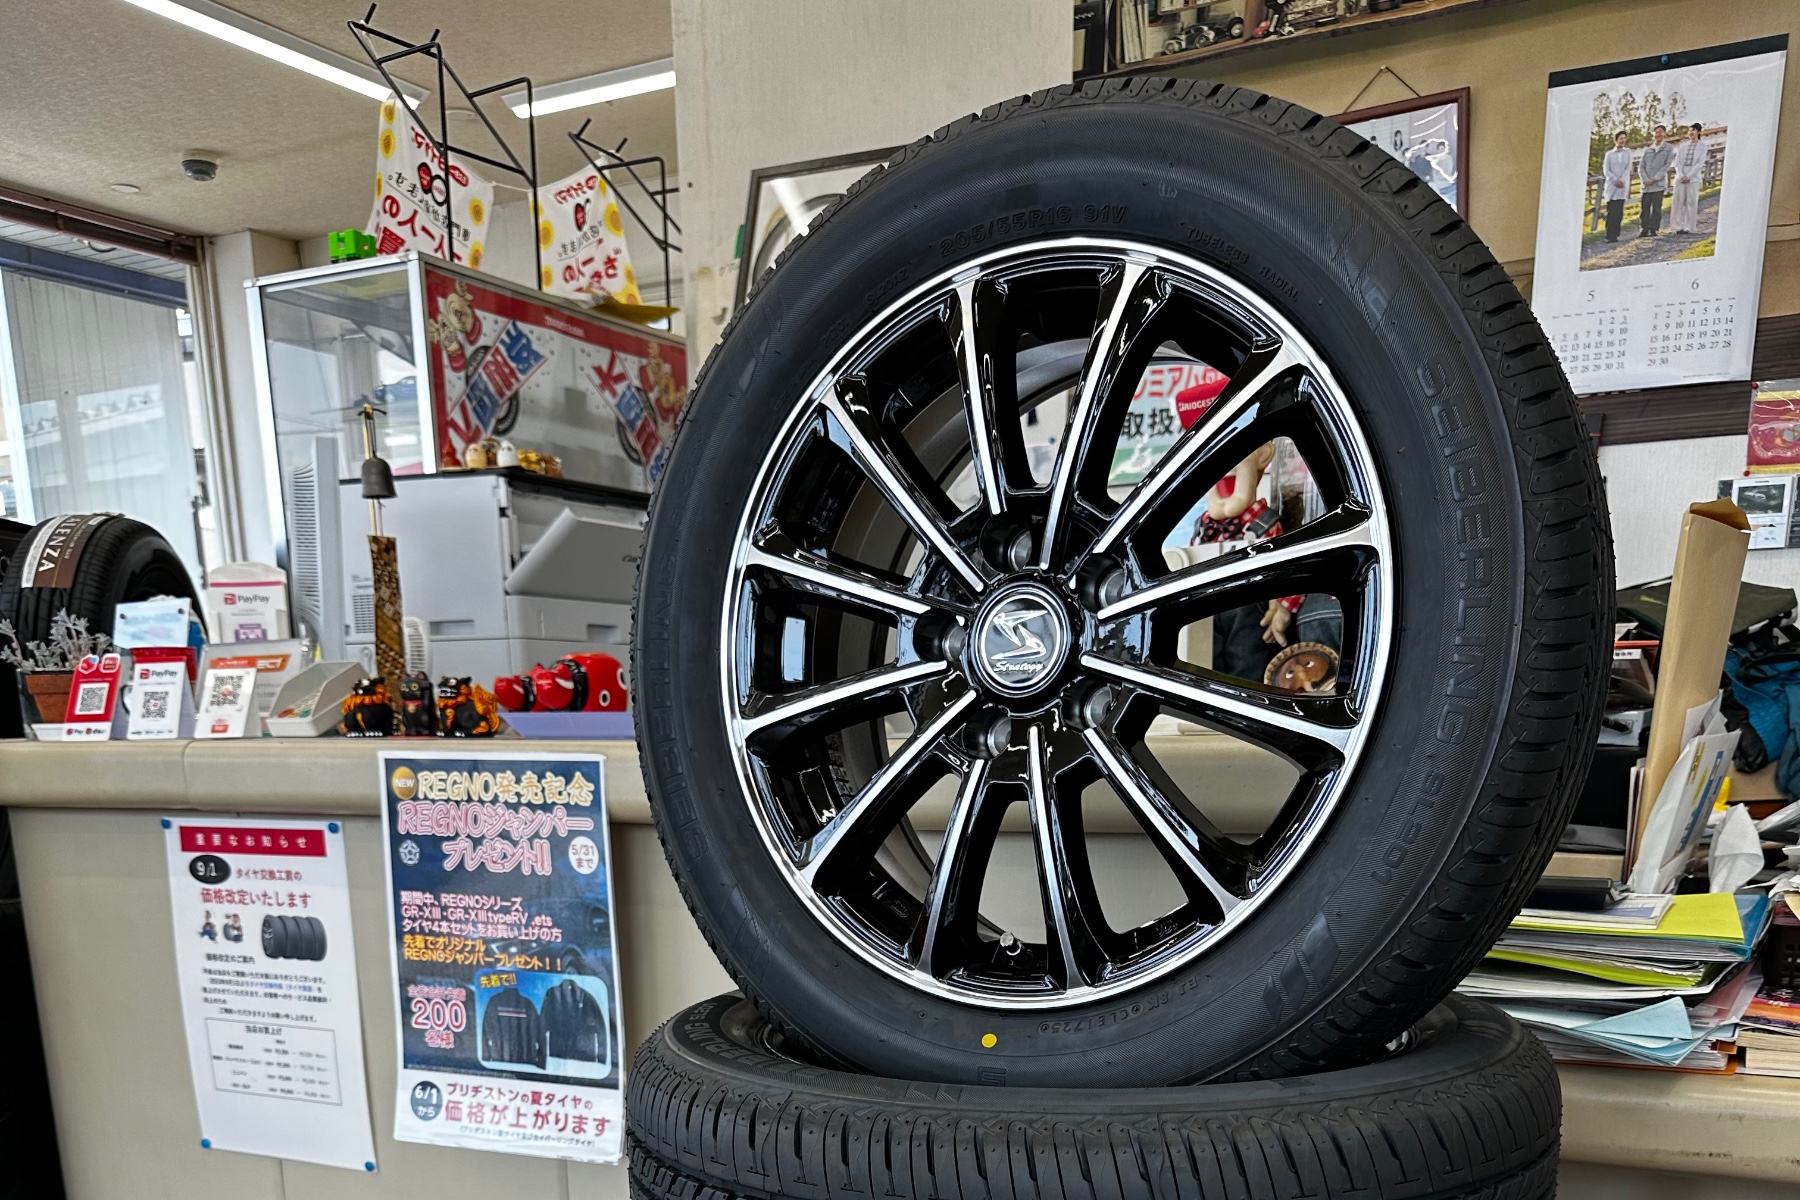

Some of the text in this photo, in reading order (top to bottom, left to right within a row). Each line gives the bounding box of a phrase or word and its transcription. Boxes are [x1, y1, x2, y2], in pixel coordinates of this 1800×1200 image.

[939, 203, 1128, 259] 205/55R16 91V
[1185, 225, 1251, 265] TUBELESS
[1691, 279, 1699, 290] 6
[1587, 290, 1595, 302] 5
[1121, 408, 1187, 440] 取扱
[38, 517, 81, 572] ALENZA
[237, 593, 271, 604] PayPay
[1369, 353, 1492, 886] SEIBERLING SL201
[150, 668, 178, 679] PayPay
[394, 778, 415, 789] NEW
[417, 769, 595, 806] REGNO発売記念
[398, 800, 594, 840] REGNOジャンパー
[194, 832, 307, 849] 重要なお知らせ
[571, 843, 595, 857] 5/31
[575, 857, 594, 869] まで
[200, 886, 312, 909] 価格改定いたします
[400, 890, 523, 912] 期間中、REGNOシリーズ
[402, 918, 562, 943] タイヤ4本セットをお買い上げの方
[403, 934, 486, 953] 先着でオリジナル
[411, 998, 467, 1033] 200
[424, 1029, 455, 1049] 名様
[414, 1085, 438, 1105] 6/1
[446, 1082, 594, 1110] ブリヂストンの夏タイヤの
[417, 1106, 436, 1118] から
[444, 1099, 611, 1137] 価格が上がります
